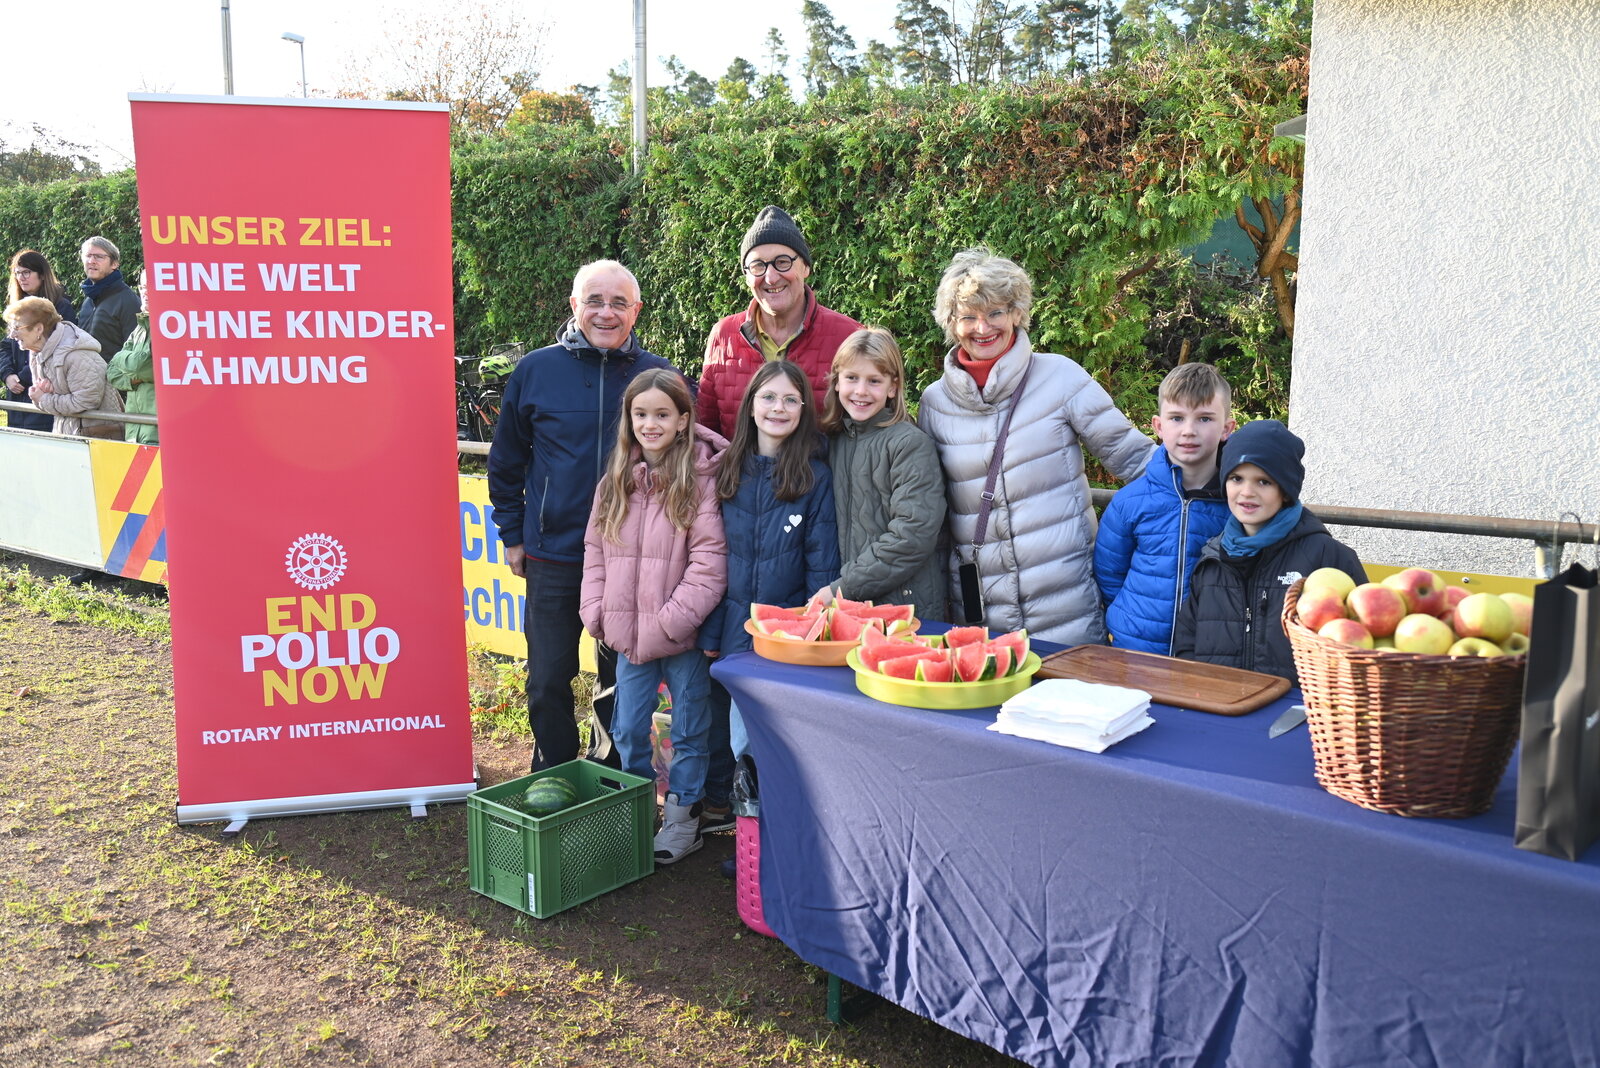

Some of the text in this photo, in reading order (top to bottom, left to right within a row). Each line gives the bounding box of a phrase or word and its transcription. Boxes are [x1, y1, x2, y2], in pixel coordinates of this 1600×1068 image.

[150, 215, 392, 247] UNSER ZIEL:
[153, 262, 361, 292] EINE WELT
[158, 310, 447, 339] OHNE KINDER-
[160, 350, 368, 386] LÄHMUNG
[302, 539, 330, 547] ROTARY
[296, 568, 340, 585] INTERNATIONAL
[266, 593, 377, 635] END
[240, 626, 400, 673] POLIO
[262, 663, 389, 707] NOW
[202, 714, 446, 745] ROTARY INTERNATIONAL
